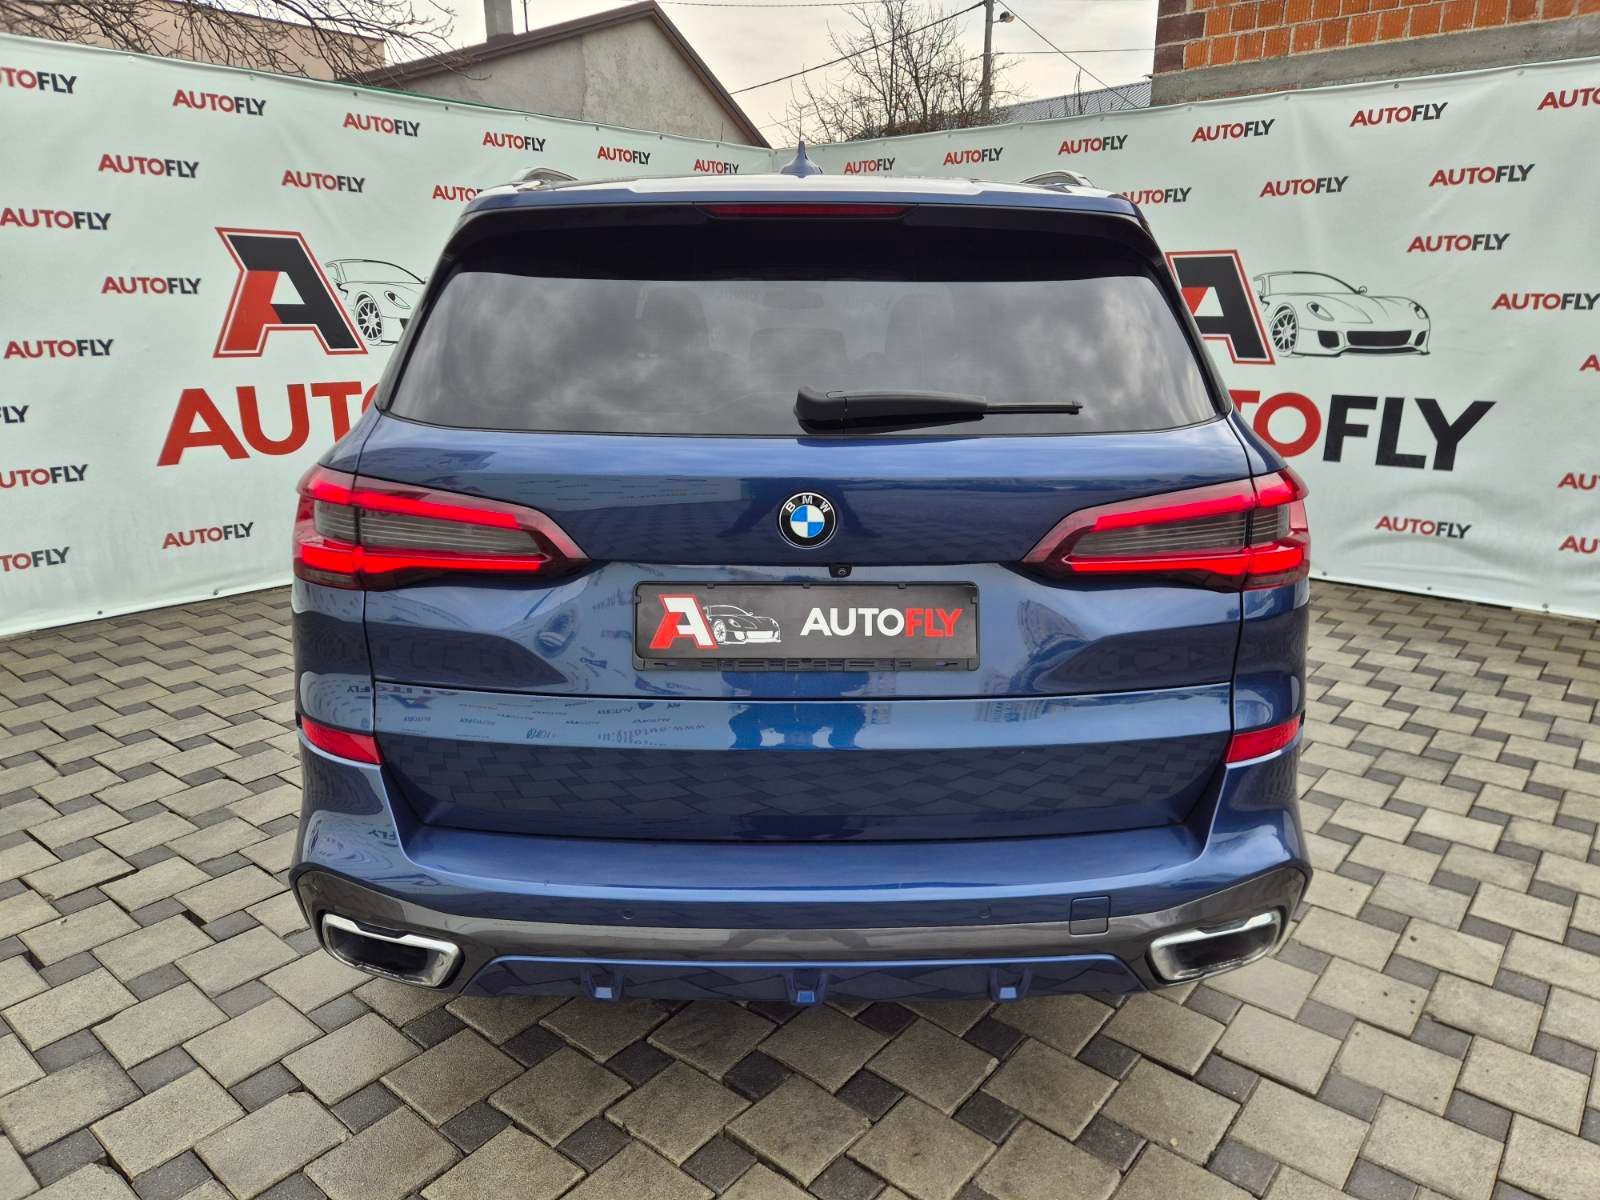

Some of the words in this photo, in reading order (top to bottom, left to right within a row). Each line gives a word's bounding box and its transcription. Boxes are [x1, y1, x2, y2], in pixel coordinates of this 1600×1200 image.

[173, 89, 267, 117] AUTOFLY
[1349, 101, 1449, 128] AUTOFLY
[343, 112, 421, 138] AUTOFLY
[1191, 118, 1276, 143] AUTOFLY
[482, 130, 547, 153] AUTOFLY
[1058, 134, 1129, 156] AUTOFLY
[98, 153, 200, 179] AUTOFLY
[597, 145, 651, 166] AUTOFLY
[844, 157, 896, 175] AUTOFLY
[943, 146, 1004, 166] AUTOFLY
[281, 169, 366, 194] AUTOFLY
[1260, 175, 1350, 198] AUTOFLY
[1428, 163, 1536, 188] AUTOFLY
[0, 207, 112, 231] AUTOFLY
[1407, 232, 1511, 254] AUTOFLY
[101, 276, 202, 295] AUTOFLY
[1491, 292, 1600, 311] AUTOFLY
[4, 338, 115, 359] AUTOFLY
[785, 495, 831, 513] BMW
[162, 521, 254, 550] AUTOFLY
[1375, 515, 1473, 540] AUTOFLY
[800, 607, 964, 638] AUTOFLY
